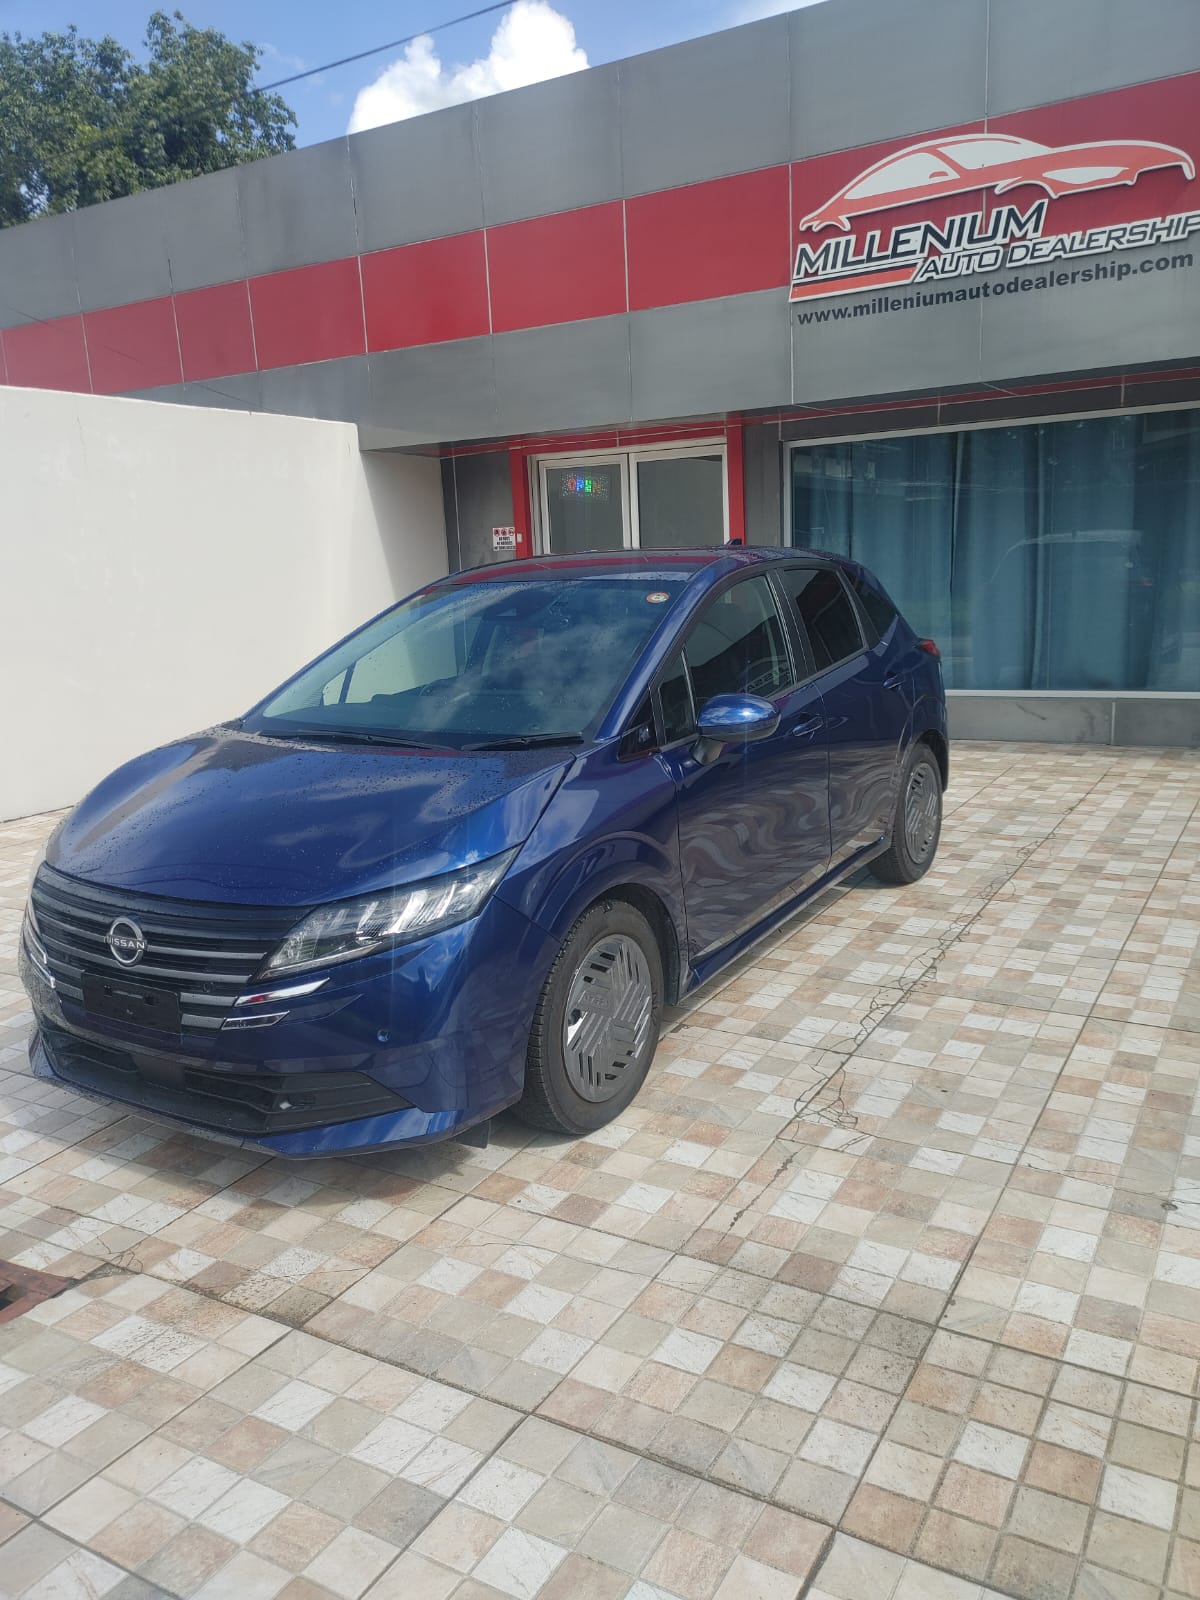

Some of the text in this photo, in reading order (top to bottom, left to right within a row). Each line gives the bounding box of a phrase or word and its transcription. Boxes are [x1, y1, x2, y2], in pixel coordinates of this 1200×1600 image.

[795, 200, 1047, 277] MILLENIUM
[918, 213, 1200, 279] AUTO DEALERSHIP
[797, 253, 1194, 325] www.milleniumautodealership.com
